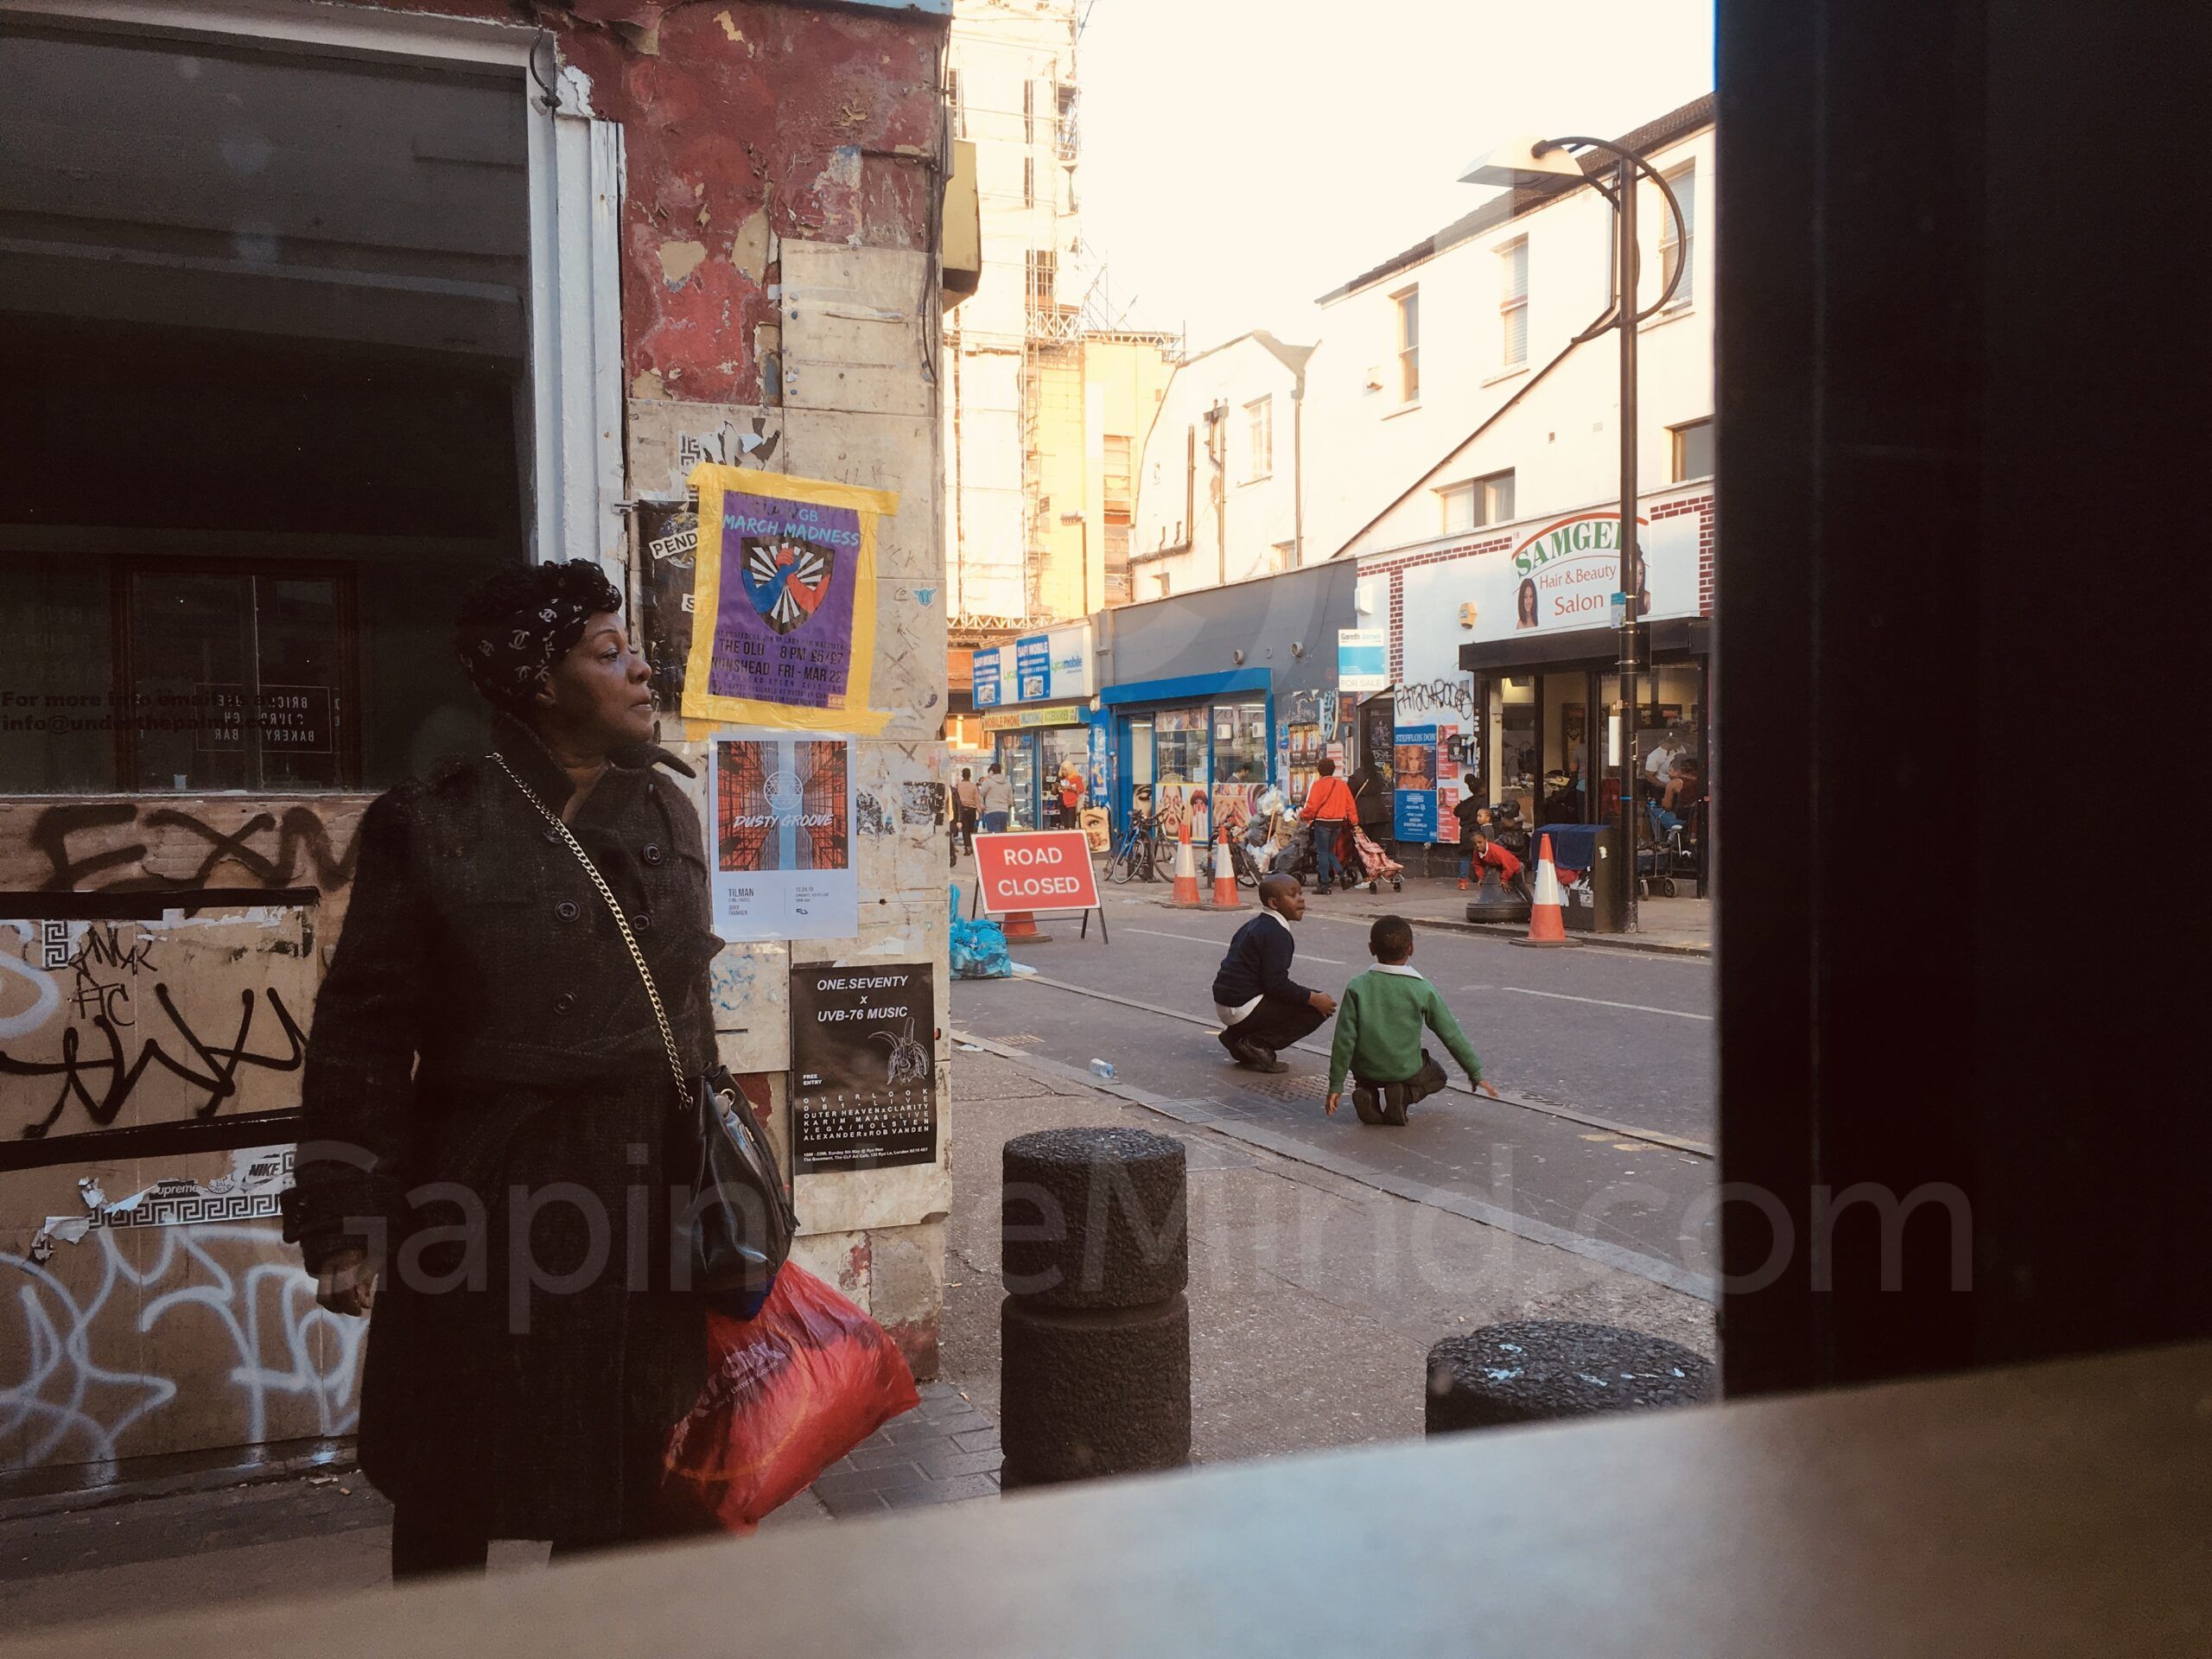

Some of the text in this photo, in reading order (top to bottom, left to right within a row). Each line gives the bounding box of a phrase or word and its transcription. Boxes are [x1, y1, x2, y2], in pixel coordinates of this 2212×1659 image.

[722, 514, 860, 546] MARCH MADNESS
[1540, 565, 1618, 589] Hair & Beauty
[1554, 594, 1605, 616] Salon
[719, 639, 741, 654] THE
[743, 641, 765, 656] OLD
[1029, 642, 1048, 655] MOBILE
[711, 657, 770, 676] NUNSHEAD
[779, 664, 794, 677] FRI
[804, 666, 827, 682] MAR
[830, 670, 842, 683] 22
[1052, 655, 1082, 674] Lycamobile
[2, 691, 39, 706] For
[45, 695, 102, 706] more
[1423, 733, 1436, 741] DON
[733, 813, 834, 828] DUSTY GROOVE
[1003, 848, 1063, 866] ROAD
[728, 888, 753, 897] TILMAN
[998, 877, 1080, 896] CLOSED
[817, 976, 909, 991] ONE.SEVENTY
[817, 1007, 908, 1022] UVB-76 MUSIC
[804, 1110, 837, 1119] OUTER
[804, 1117, 846, 1127] KARIM
[892, 1125, 929, 1135] VANDEN
[249, 1163, 281, 1176] NIKE
